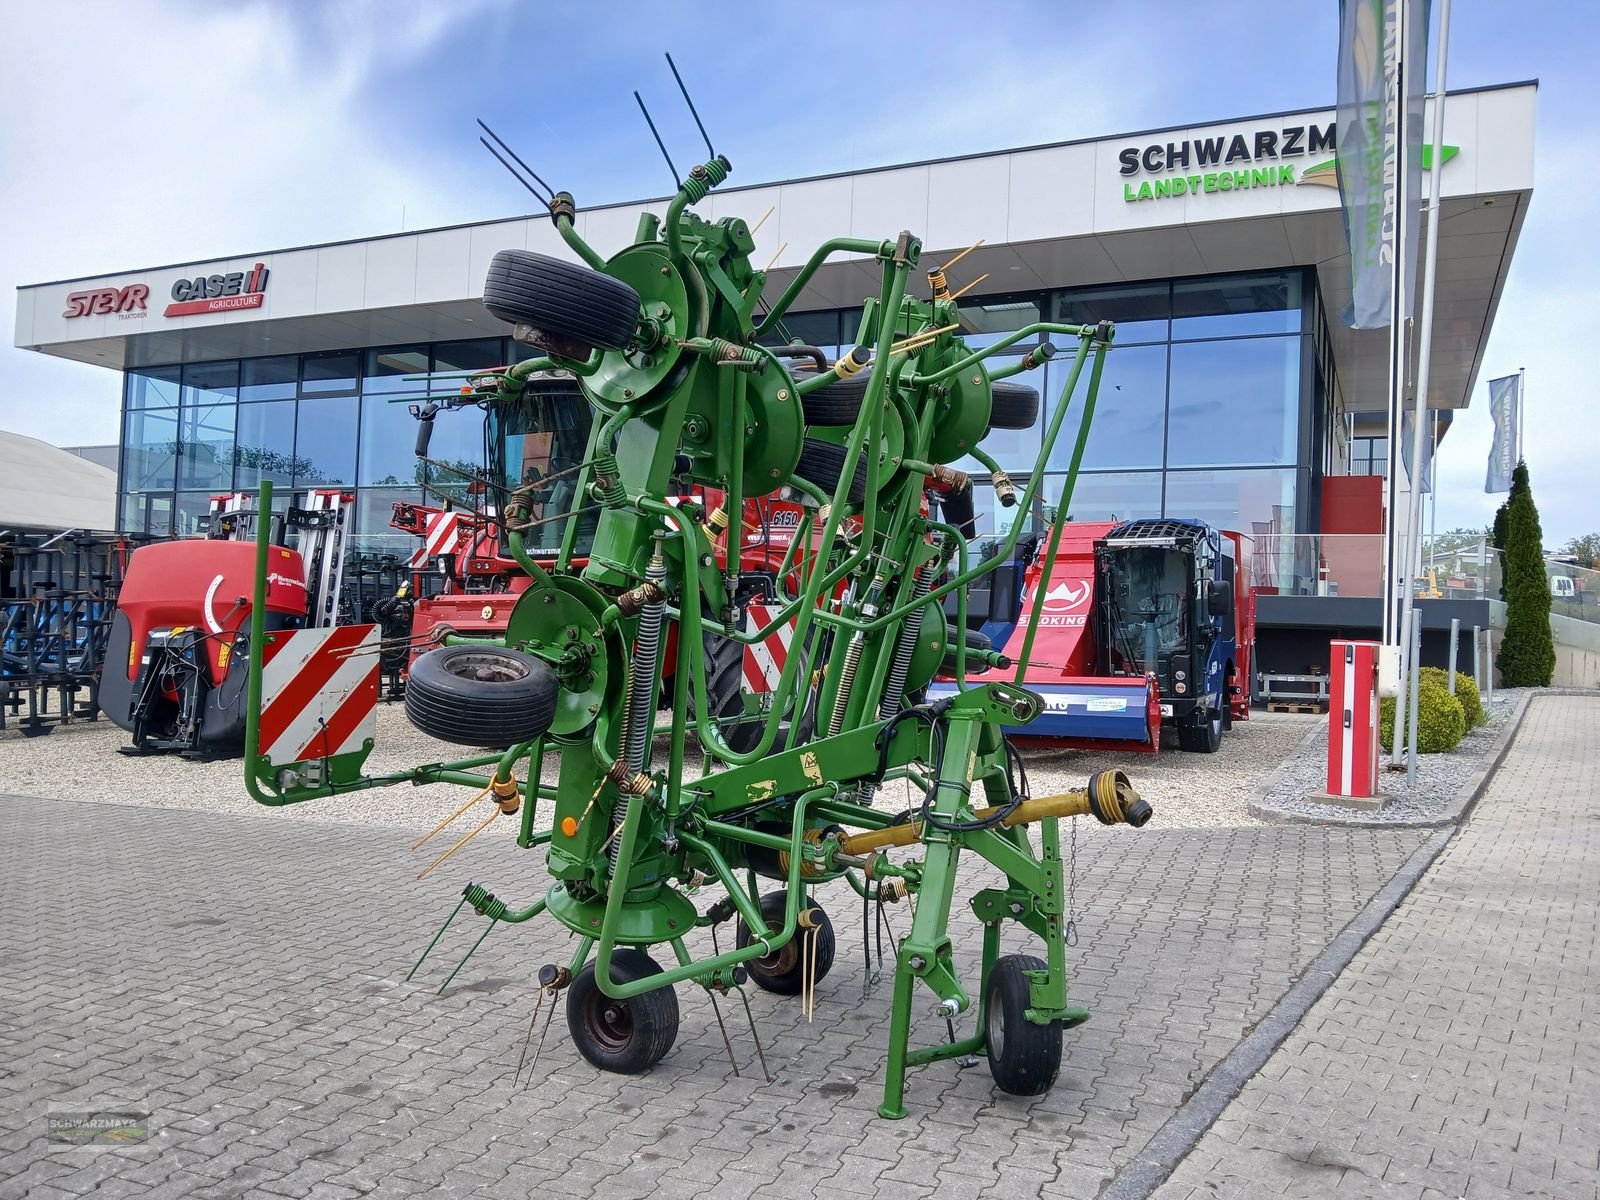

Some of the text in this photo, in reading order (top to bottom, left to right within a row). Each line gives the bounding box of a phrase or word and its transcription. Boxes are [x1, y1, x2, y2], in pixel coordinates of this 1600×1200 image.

[1124, 164, 1295, 202] LANDTECHNIK
[62, 284, 149, 318] STEYR
[171, 272, 244, 302] CASE
[209, 296, 258, 310] AGRICULTURE
[773, 511, 799, 526] 6150
